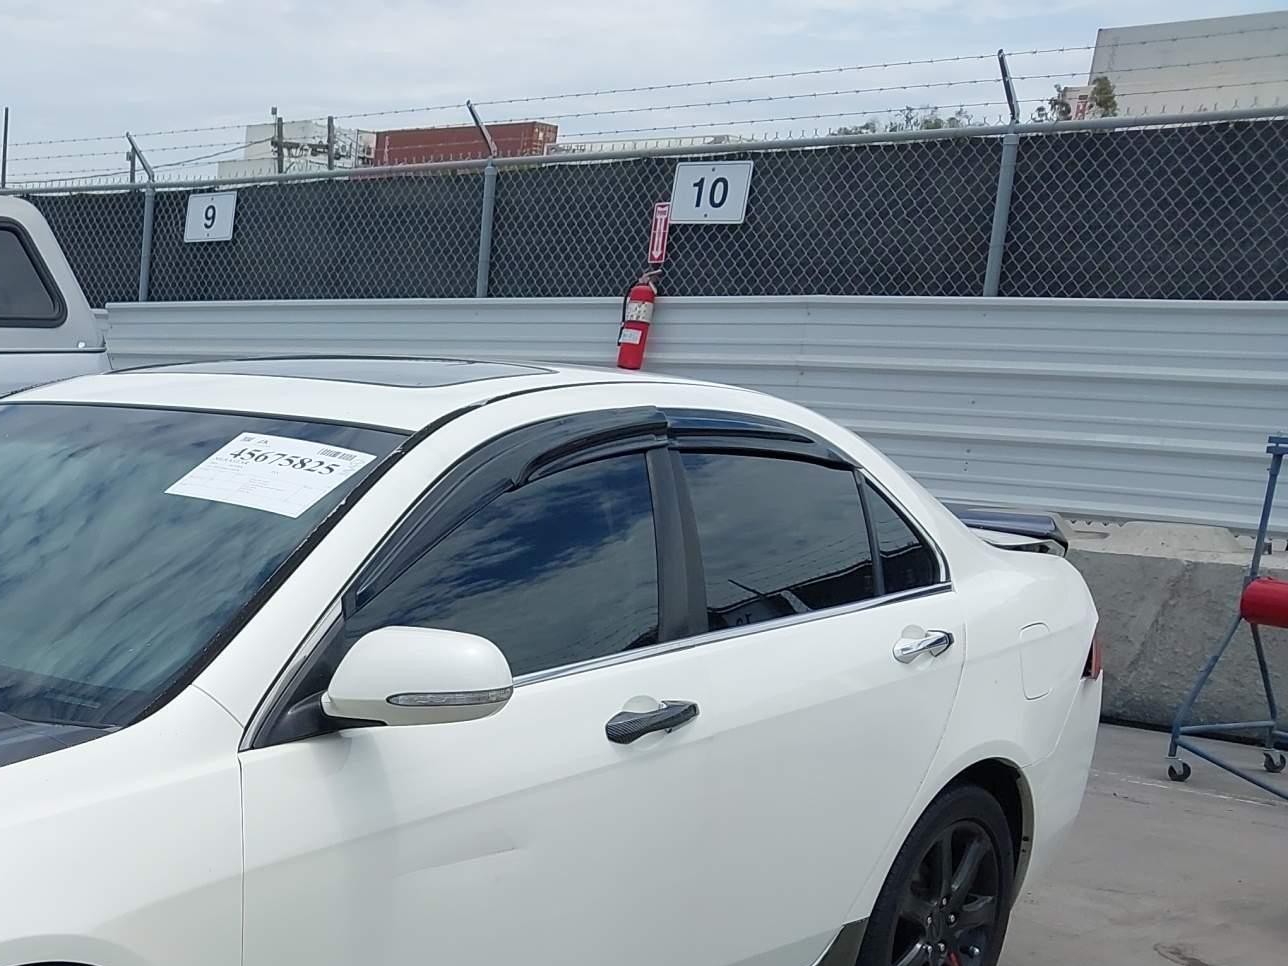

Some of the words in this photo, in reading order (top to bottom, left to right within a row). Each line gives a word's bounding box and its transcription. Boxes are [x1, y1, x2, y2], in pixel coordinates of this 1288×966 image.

[692, 177, 729, 208] 10
[203, 204, 216, 229] 9
[229, 447, 341, 475] 45675825
